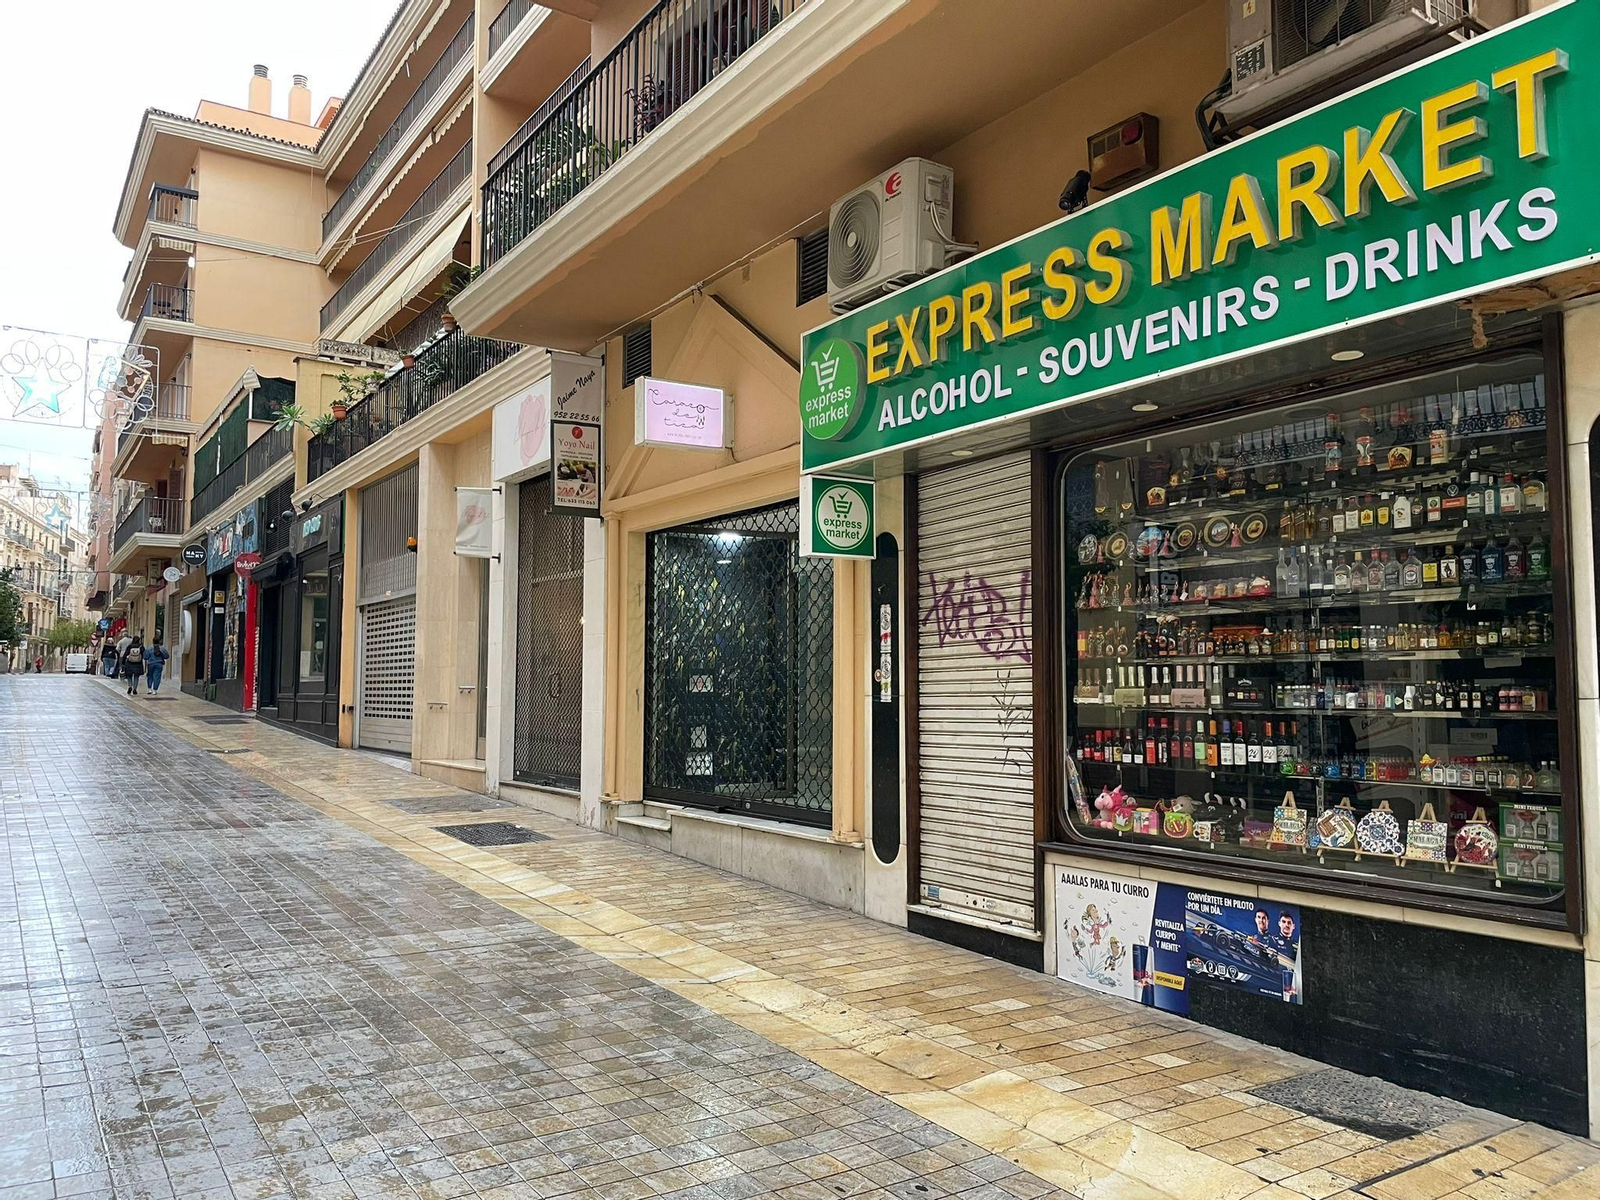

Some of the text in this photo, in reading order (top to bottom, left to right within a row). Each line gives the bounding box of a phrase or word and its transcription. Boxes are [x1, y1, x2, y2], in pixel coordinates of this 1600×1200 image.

[866, 48, 1566, 384] EXPRESS MARKET
[877, 364, 1011, 432] ALCOHOL
[1038, 275, 1279, 384] SOUVENIRS
[1326, 187, 1559, 301] DRINKS
[557, 370, 596, 410] Jaime Naya
[805, 386, 851, 412] express
[553, 411, 568, 419] 952
[808, 402, 849, 429] market
[558, 438, 595, 450] Yoyo Nail
[823, 518, 862, 530] express
[826, 529, 860, 540] market
[1061, 873, 1149, 898] AAALAS PARA TU CURRO
[1187, 892, 1254, 911] CONVIÉRTETE EN PILOTO
[1200, 904, 1209, 913] UN
[1210, 904, 1223, 915] DÍA.
[1155, 918, 1184, 932] REVITALIZA
[1155, 929, 1176, 941] CUERPO
